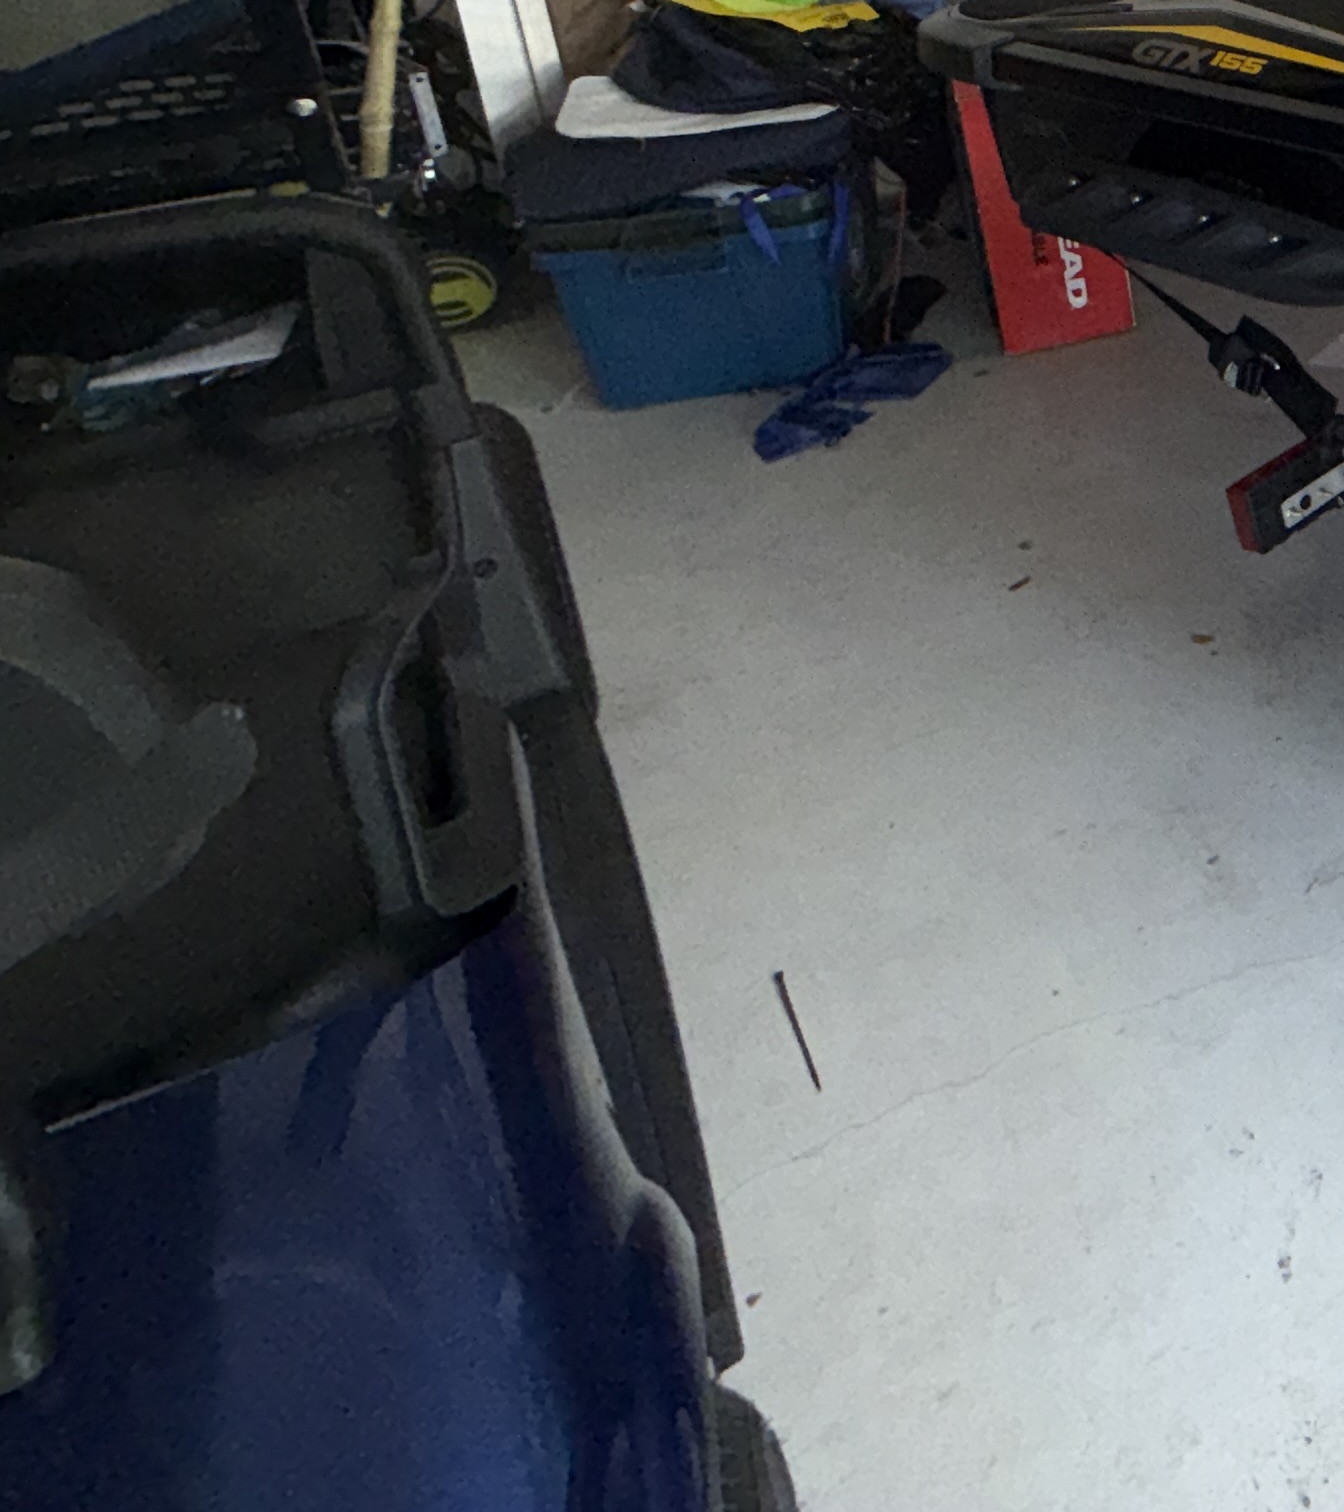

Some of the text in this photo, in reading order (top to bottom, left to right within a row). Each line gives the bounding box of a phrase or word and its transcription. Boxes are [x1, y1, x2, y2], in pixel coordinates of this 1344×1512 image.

[1132, 39, 1268, 75] GTX 155
[1057, 236, 1088, 309] EAD
